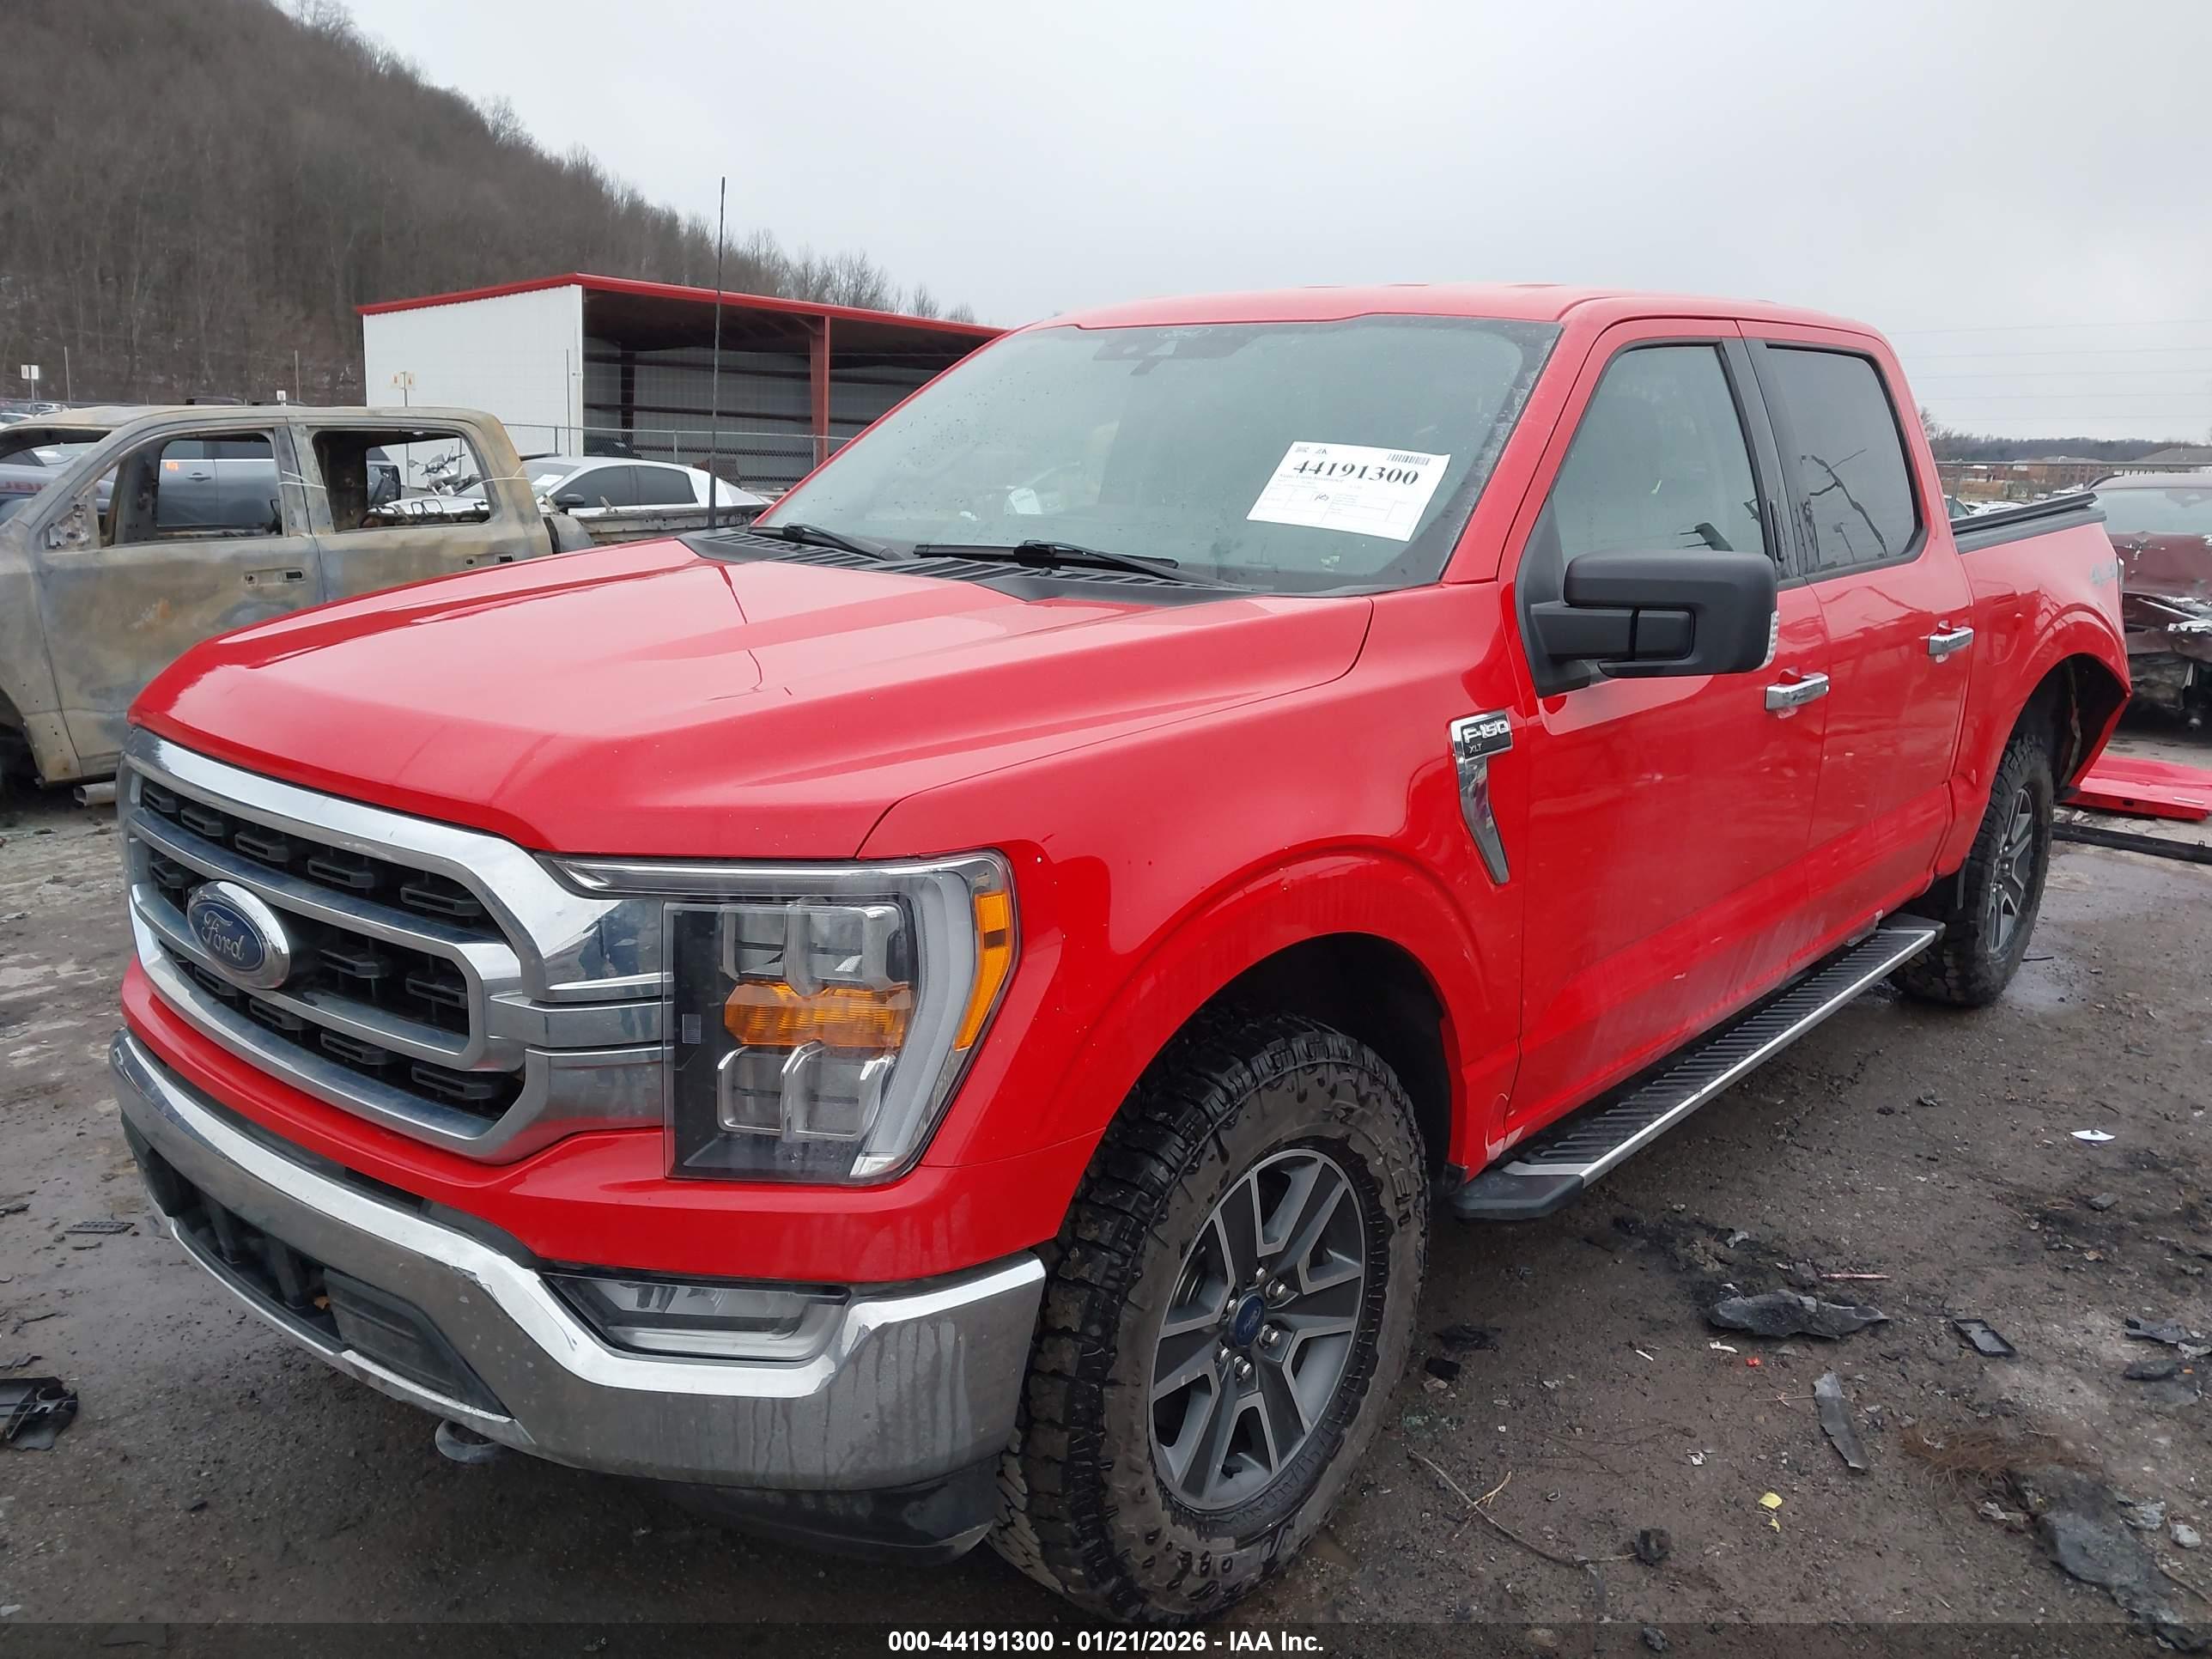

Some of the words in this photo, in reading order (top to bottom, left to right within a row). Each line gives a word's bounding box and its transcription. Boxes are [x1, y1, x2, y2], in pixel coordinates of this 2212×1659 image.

[1293, 459, 1419, 485] 44191300
[1463, 720, 1510, 743] F-150
[1469, 744, 1482, 753] XLT
[201, 910, 245, 961] Ford
